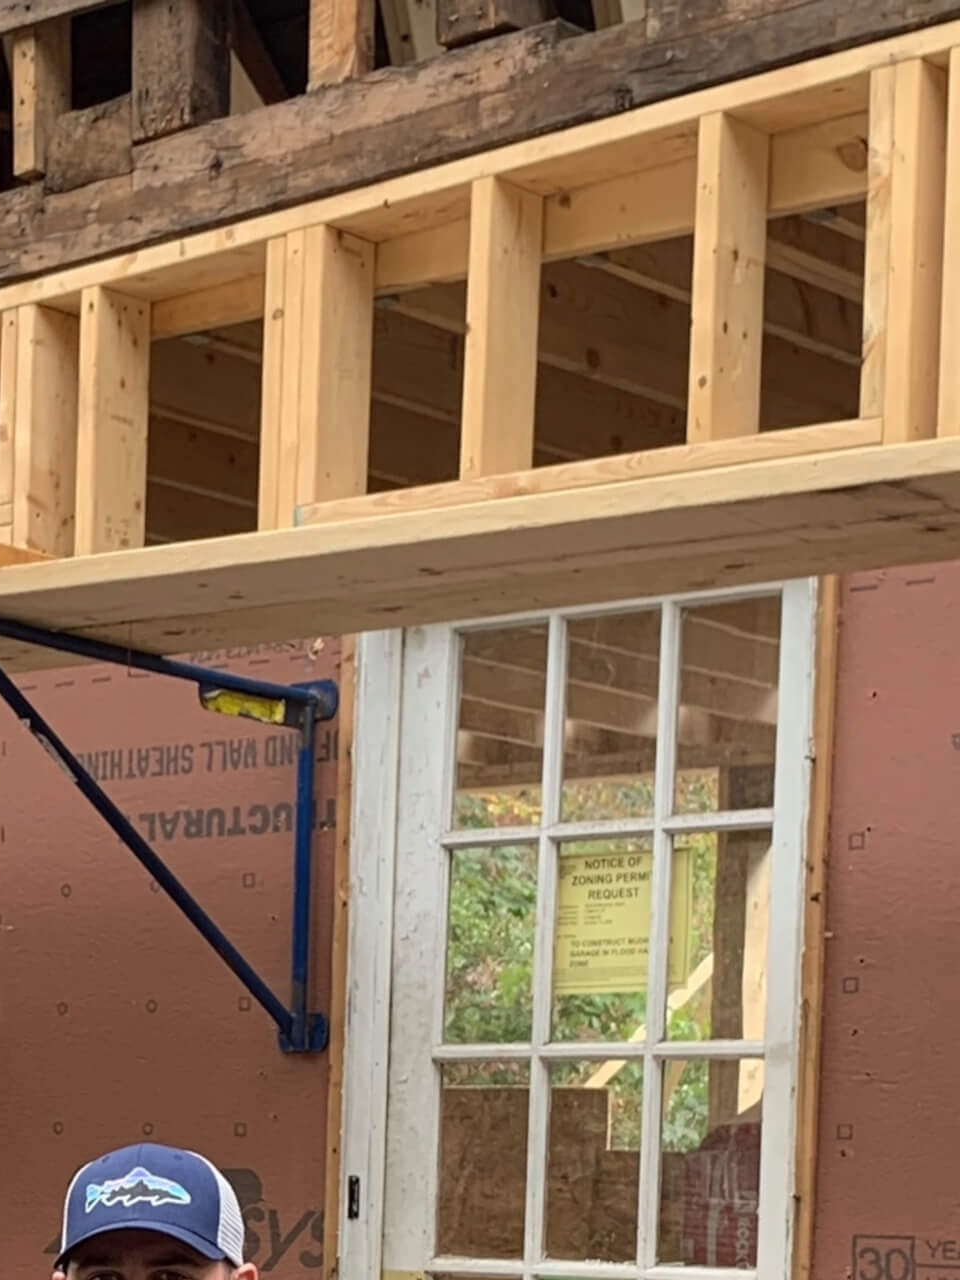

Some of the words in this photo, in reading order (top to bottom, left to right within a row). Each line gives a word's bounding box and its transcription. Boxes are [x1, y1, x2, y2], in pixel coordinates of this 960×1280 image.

[77, 743, 195, 781] SHEATHIN
[199, 738, 257, 772] WALL
[585, 857, 624, 870] NOTICE
[627, 856, 643, 867] OF
[571, 873, 613, 887] ZONING
[616, 870, 652, 884] PERMI
[587, 887, 640, 900] REQUEST
[925, 1239, 960, 1261] YE
